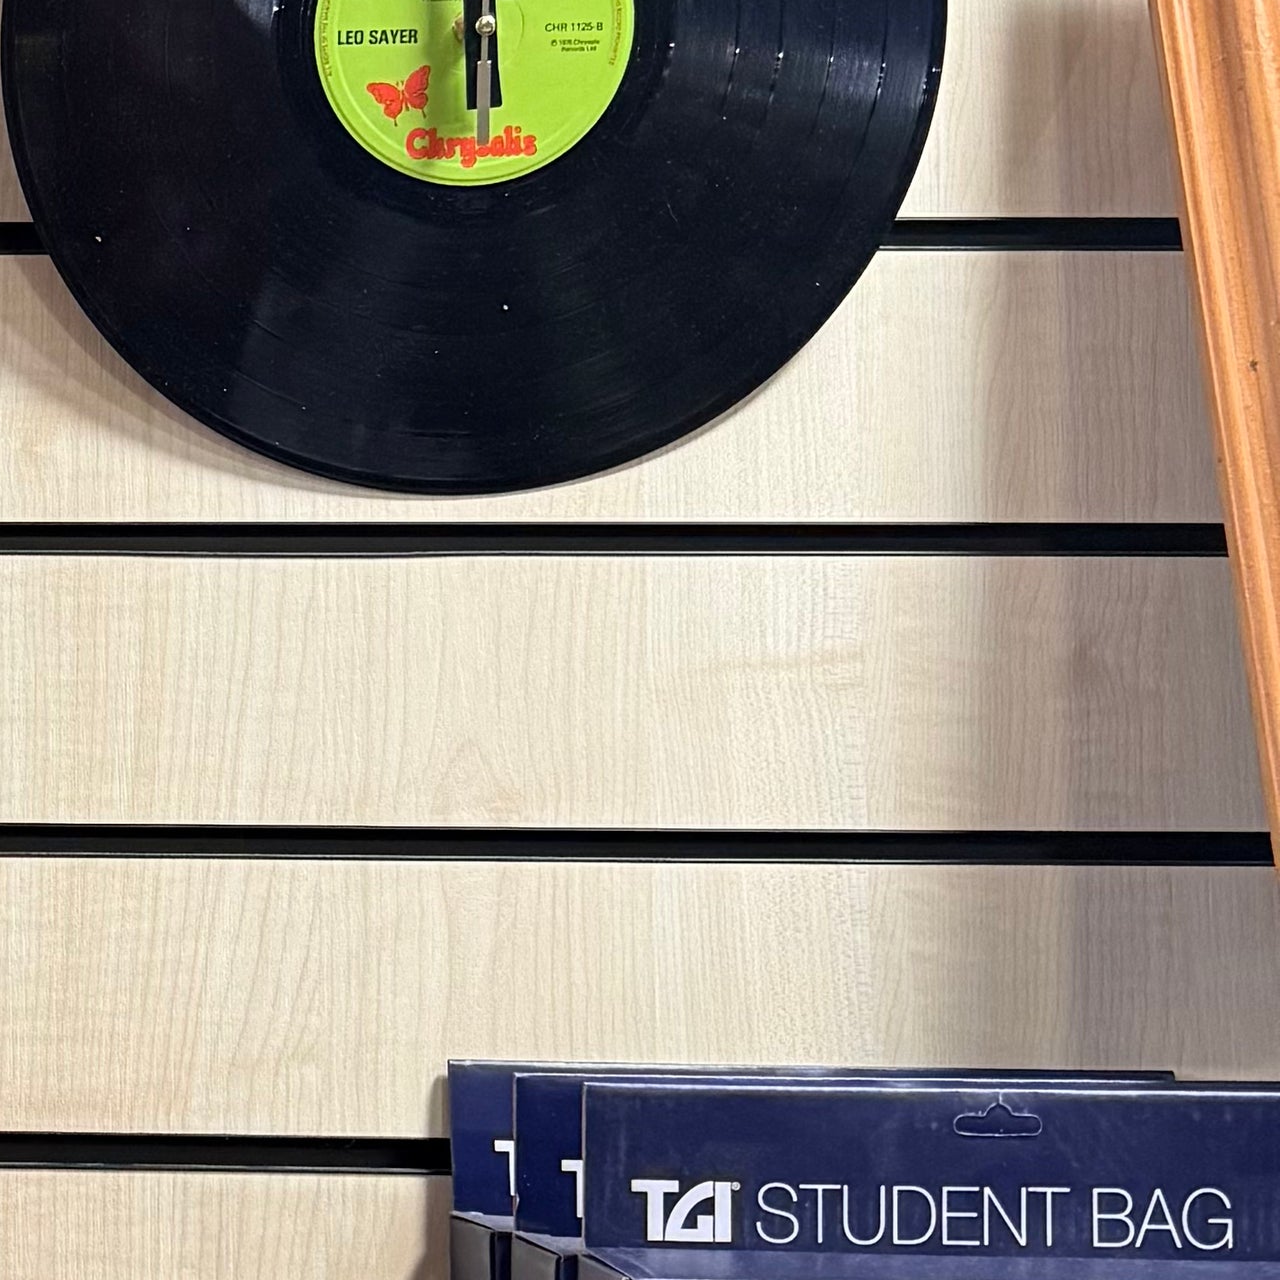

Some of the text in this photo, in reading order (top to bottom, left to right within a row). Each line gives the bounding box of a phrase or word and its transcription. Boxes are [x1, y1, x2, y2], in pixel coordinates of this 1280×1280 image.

[338, 29, 418, 45] LEO SAYER
[755, 1181, 1072, 1247] STUDENT
[1092, 1188, 1235, 1250] BAG
